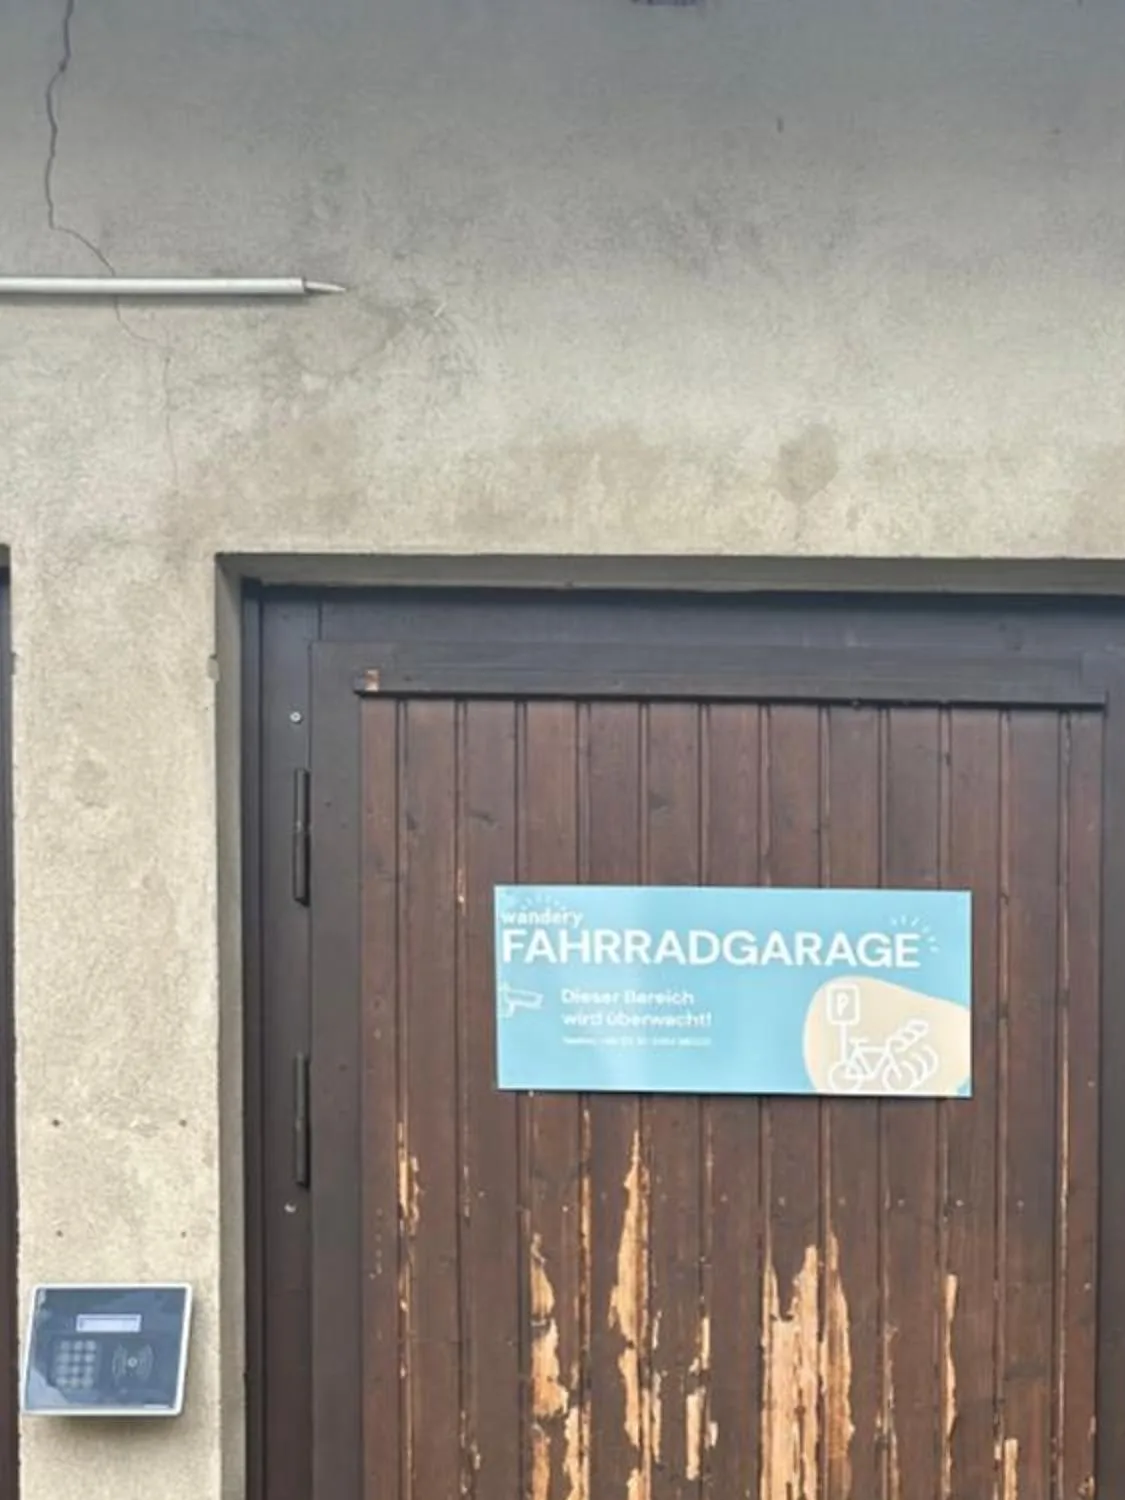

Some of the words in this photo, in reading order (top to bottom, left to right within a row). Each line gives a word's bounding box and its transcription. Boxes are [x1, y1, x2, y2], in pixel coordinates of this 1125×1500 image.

[501, 908, 583, 928] wandery
[502, 928, 922, 968] FAHRRADGARAGE
[561, 988, 619, 1005] Dieser
[624, 989, 695, 1006] Bereich
[561, 1011, 603, 1026] wird
[607, 1010, 713, 1028] überwacht!
